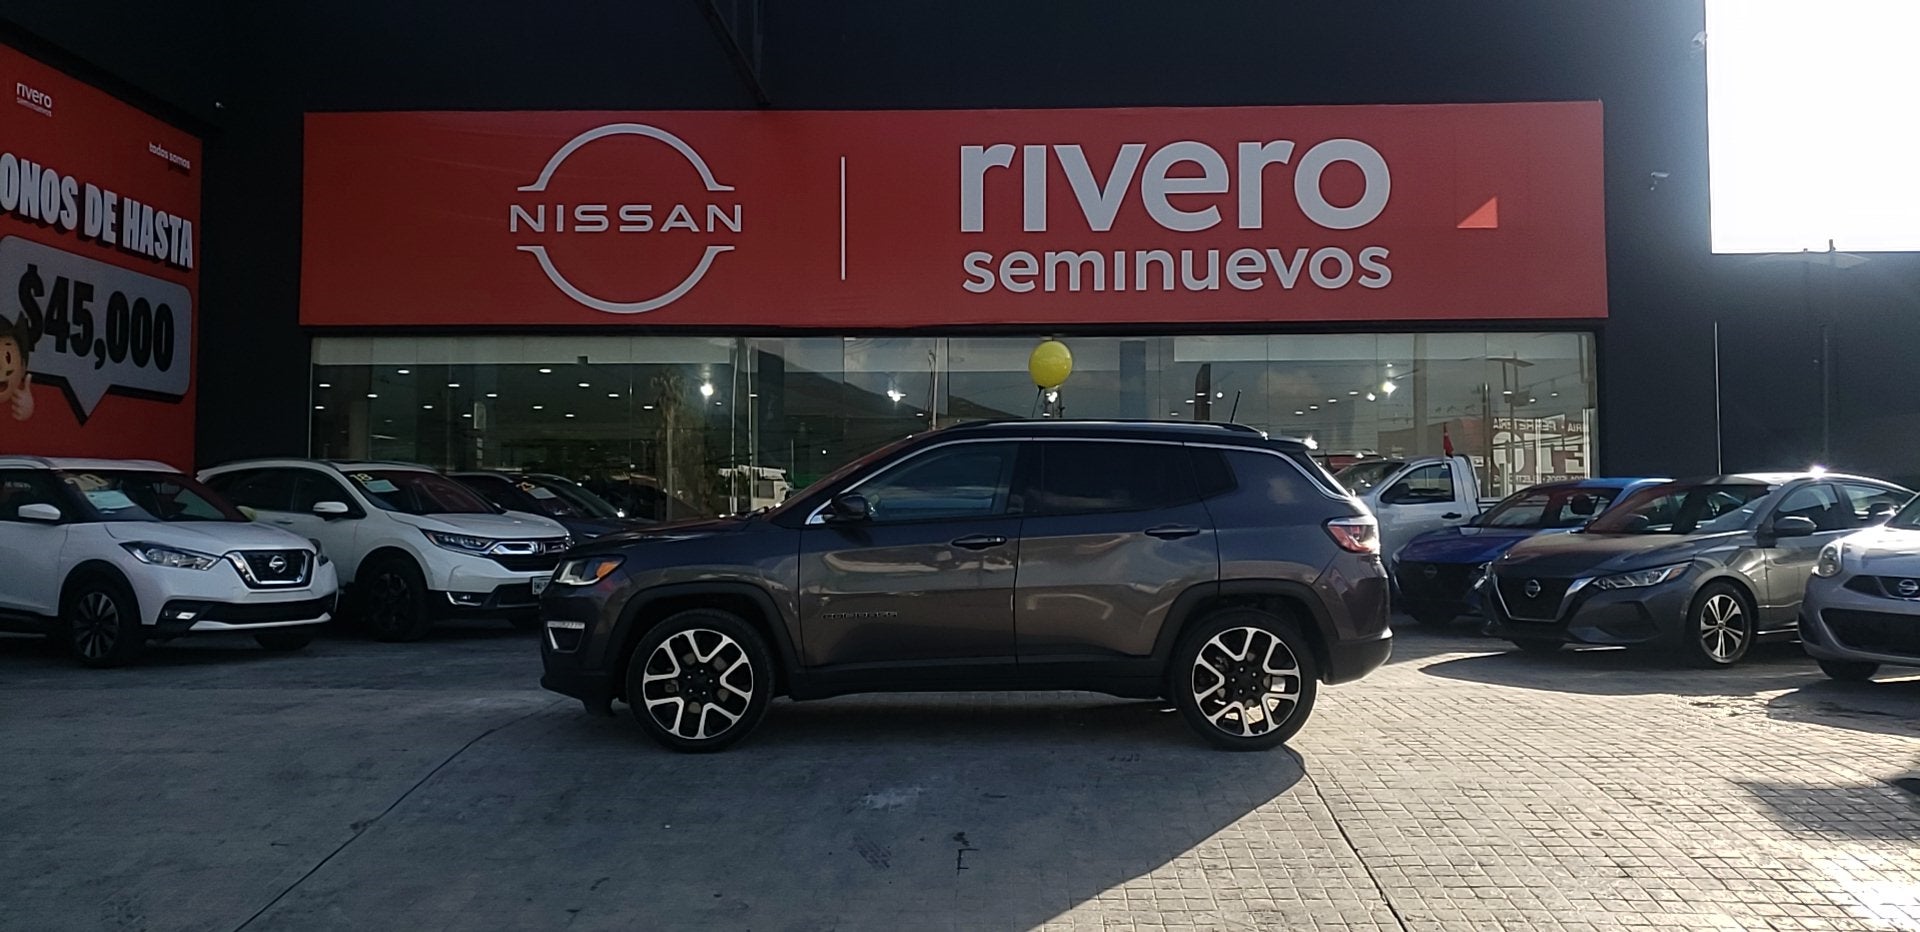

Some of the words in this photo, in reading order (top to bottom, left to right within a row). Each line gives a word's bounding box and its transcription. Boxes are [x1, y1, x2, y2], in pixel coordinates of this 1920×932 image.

[16, 82, 52, 108] rivero
[149, 142, 169, 160] todos
[169, 153, 191, 169] somos
[960, 138, 1391, 232] rivero
[84, 183, 118, 244] DE
[123, 197, 193, 269] HASTA
[510, 204, 741, 232] NISSAN
[962, 246, 1392, 293] seminuevos
[18, 263, 175, 372] $45,000
